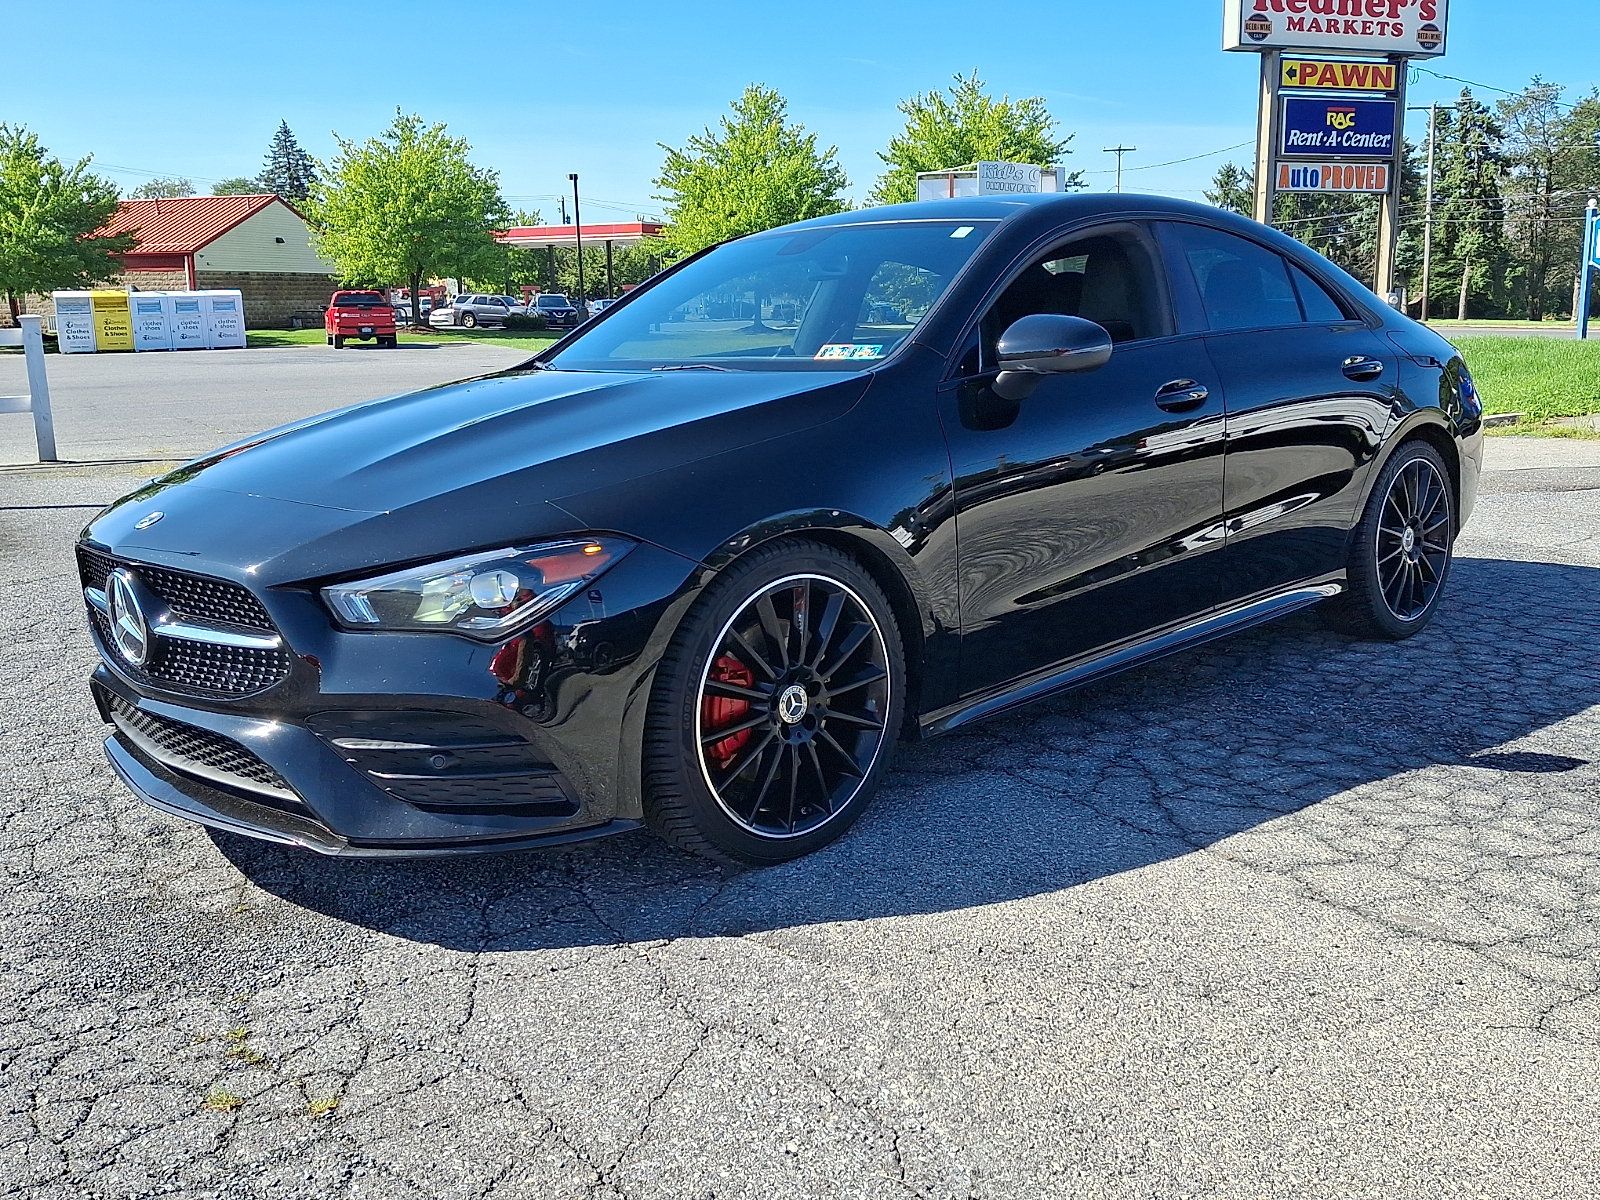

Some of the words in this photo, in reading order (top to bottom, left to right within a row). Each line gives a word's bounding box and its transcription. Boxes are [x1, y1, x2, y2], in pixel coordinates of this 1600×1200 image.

[1286, 16, 1404, 37] MARKETS
[1299, 63, 1392, 88] PAWN
[1326, 112, 1355, 129] RAC
[986, 181, 1016, 191] FAMILY
